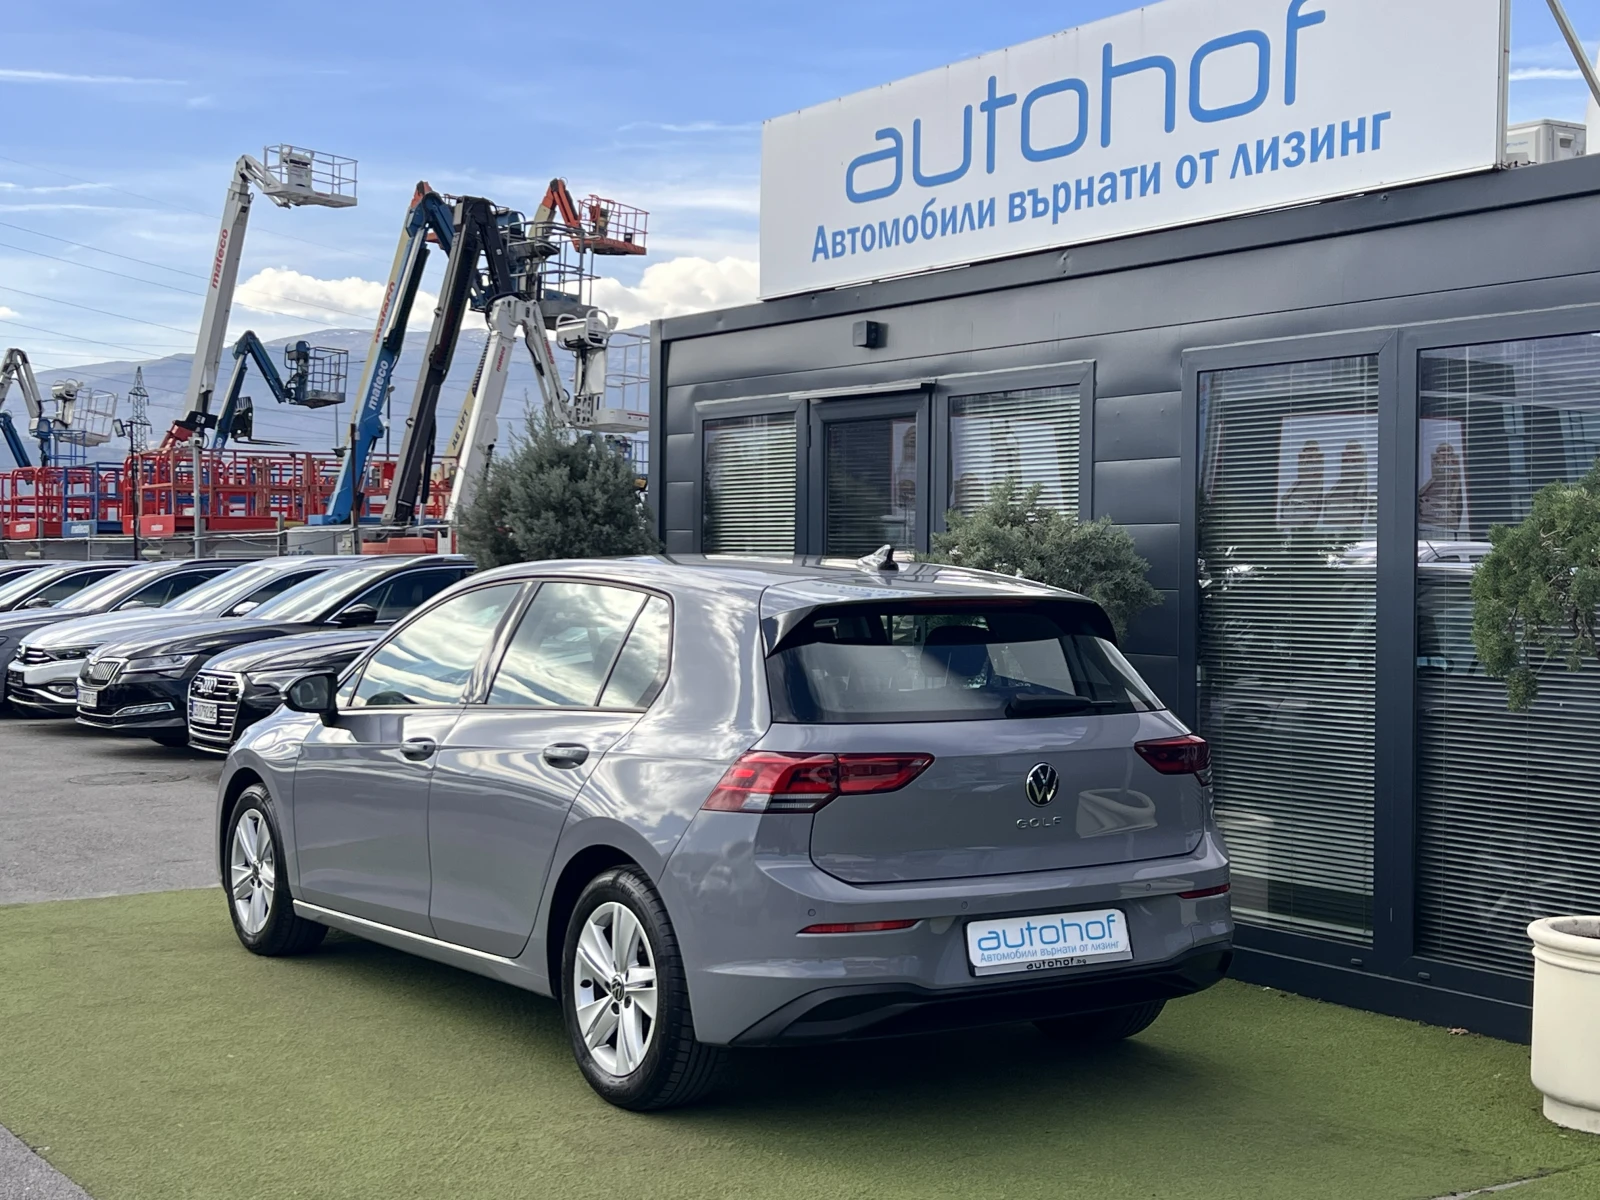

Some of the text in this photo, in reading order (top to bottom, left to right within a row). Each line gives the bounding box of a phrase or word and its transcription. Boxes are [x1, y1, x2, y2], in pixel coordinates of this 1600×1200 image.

[845, 0, 1327, 204] autohof
[811, 111, 1391, 262] Автомобили върнати от лизинг
[212, 228, 228, 289] mateco
[368, 360, 389, 411] mateco
[1016, 816, 1062, 829] GOLF
[977, 913, 1116, 951] autohof
[980, 940, 1120, 963] Автомобили върнати от лизинг
